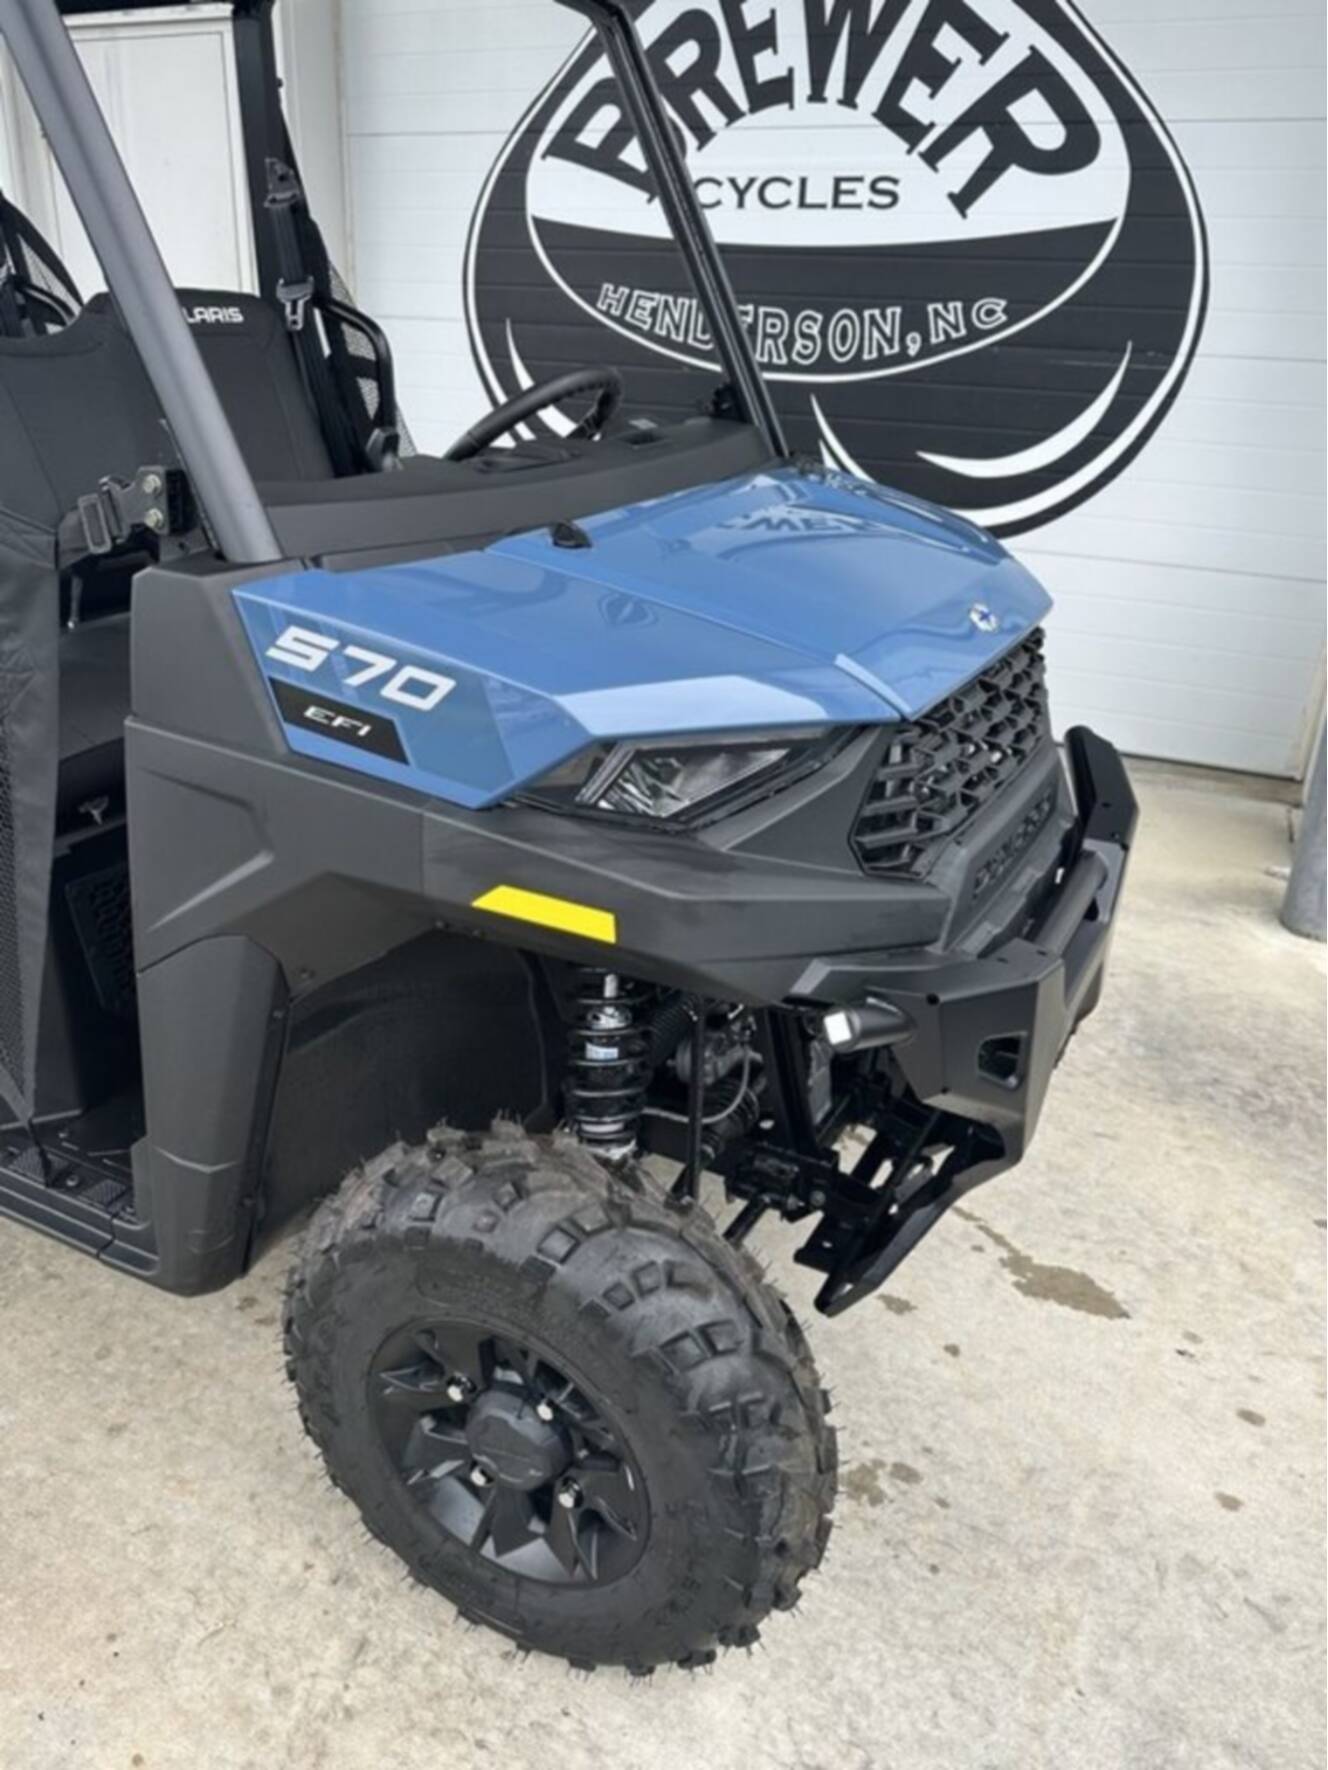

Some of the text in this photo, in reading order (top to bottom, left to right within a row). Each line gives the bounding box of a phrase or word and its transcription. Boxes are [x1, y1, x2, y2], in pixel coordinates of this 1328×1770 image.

[541, 0, 1101, 219] BREWER
[694, 176, 901, 210] CYCLES
[182, 306, 244, 323] LARIS
[597, 283, 1008, 365] HENRSON, NC
[265, 625, 457, 712] 570
[303, 705, 372, 737] EFI
